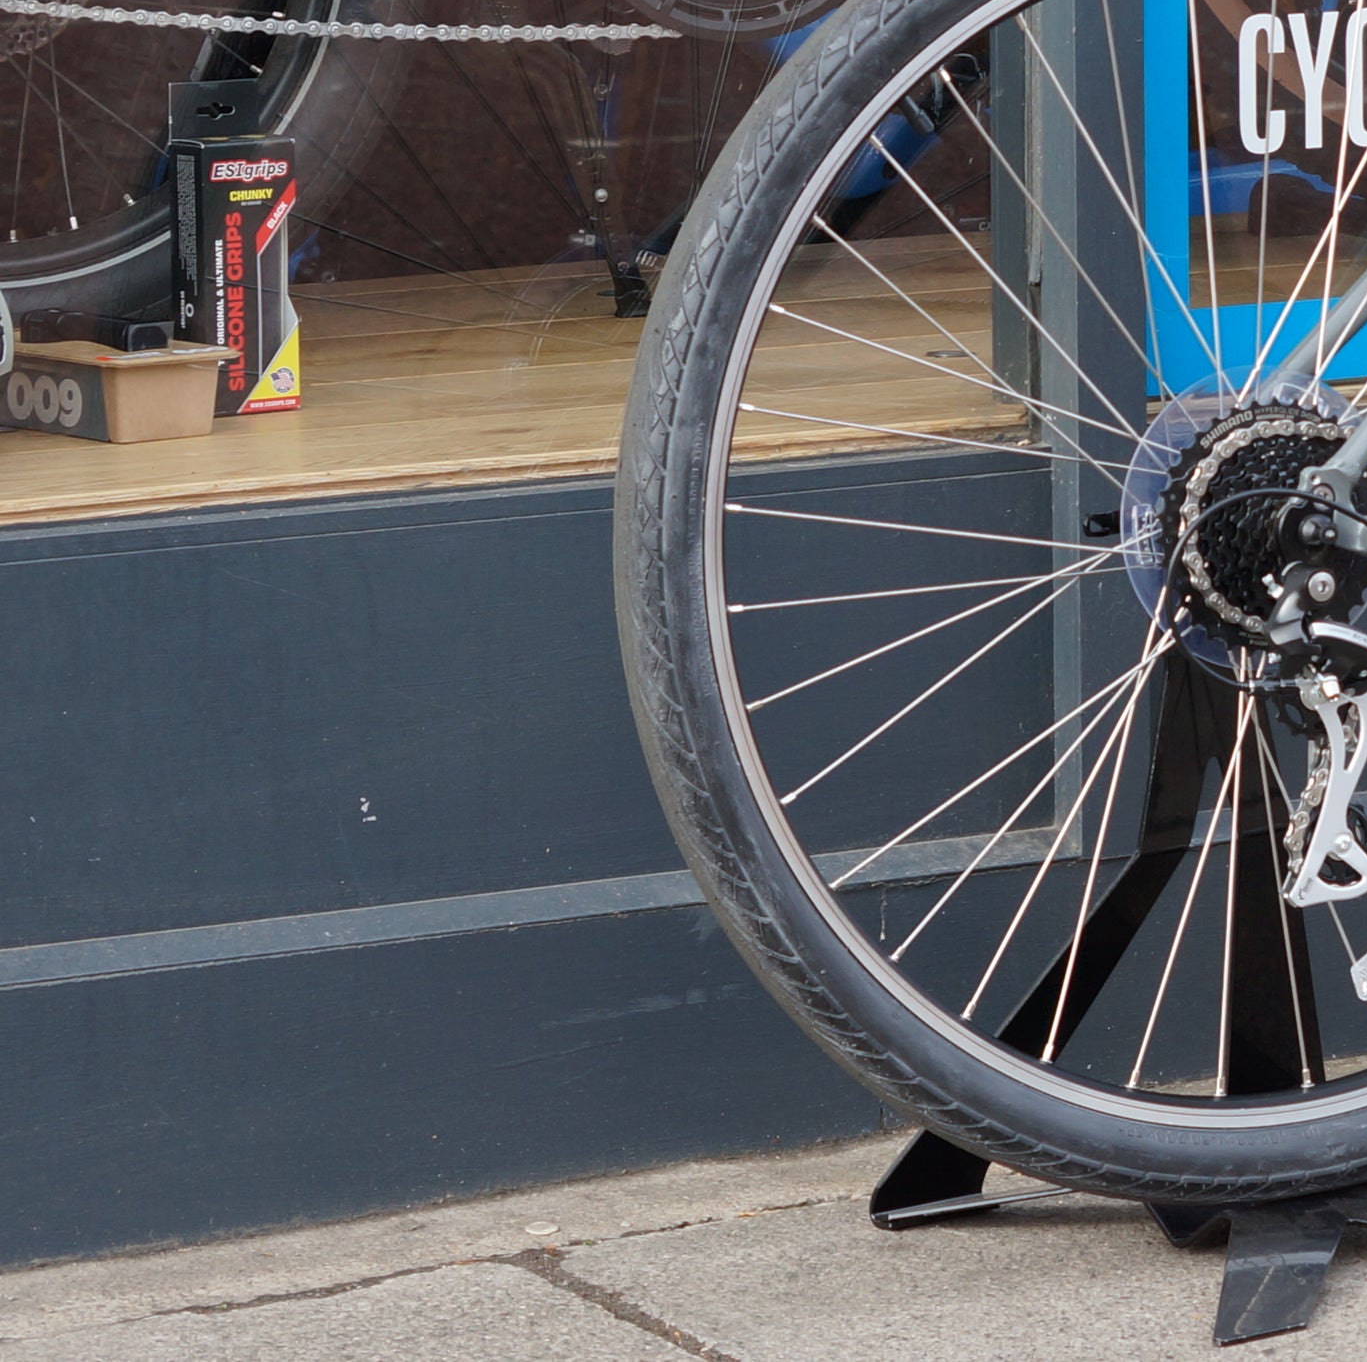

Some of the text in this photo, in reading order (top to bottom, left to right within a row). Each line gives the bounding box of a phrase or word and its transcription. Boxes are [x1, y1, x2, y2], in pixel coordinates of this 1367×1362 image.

[212, 160, 287, 181] ESIgrips
[229, 188, 273, 201] CHUNKY
[266, 201, 288, 230] BLACK
[225, 211, 243, 281] GRIPS
[215, 239, 225, 345] ORIGINAL & ULTIMATE
[7, 372, 83, 428] 009
[1200, 410, 1254, 449] SHIMANO
